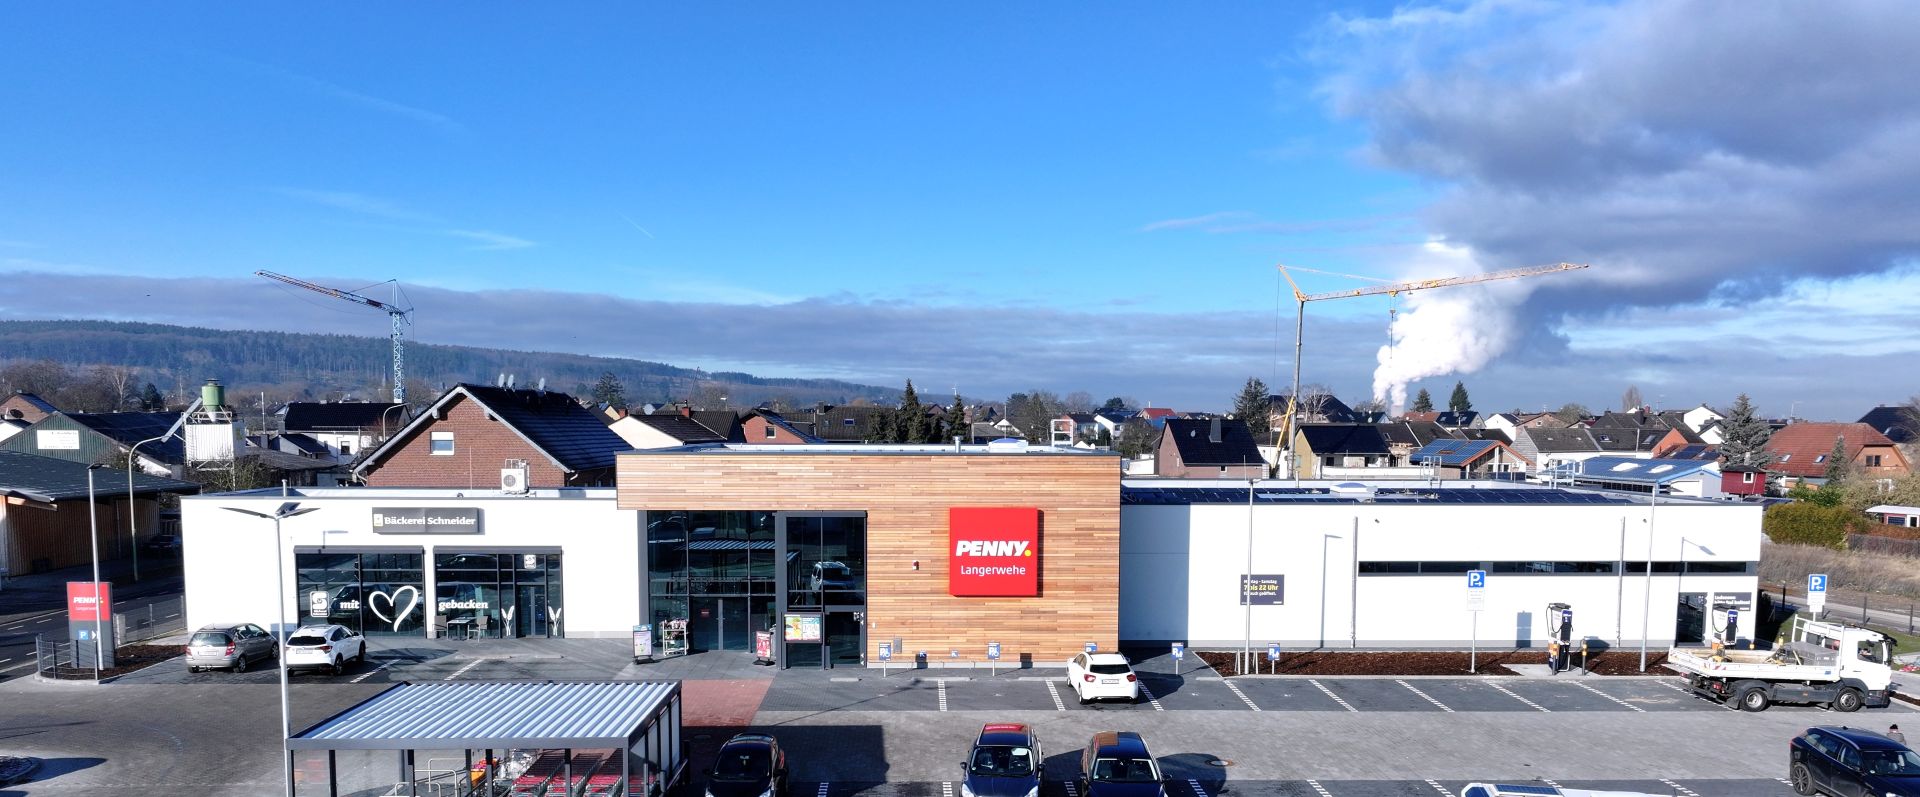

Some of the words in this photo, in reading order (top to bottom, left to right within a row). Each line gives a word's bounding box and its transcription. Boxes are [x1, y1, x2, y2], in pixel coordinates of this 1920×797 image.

[384, 516, 425, 525] Bäckerei
[427, 516, 476, 525] Schneider
[960, 564, 1026, 577] Langerwehe
[1470, 572, 1480, 586] P
[1811, 576, 1821, 591] P
[340, 599, 360, 609] mit
[438, 600, 488, 611] gebacken
